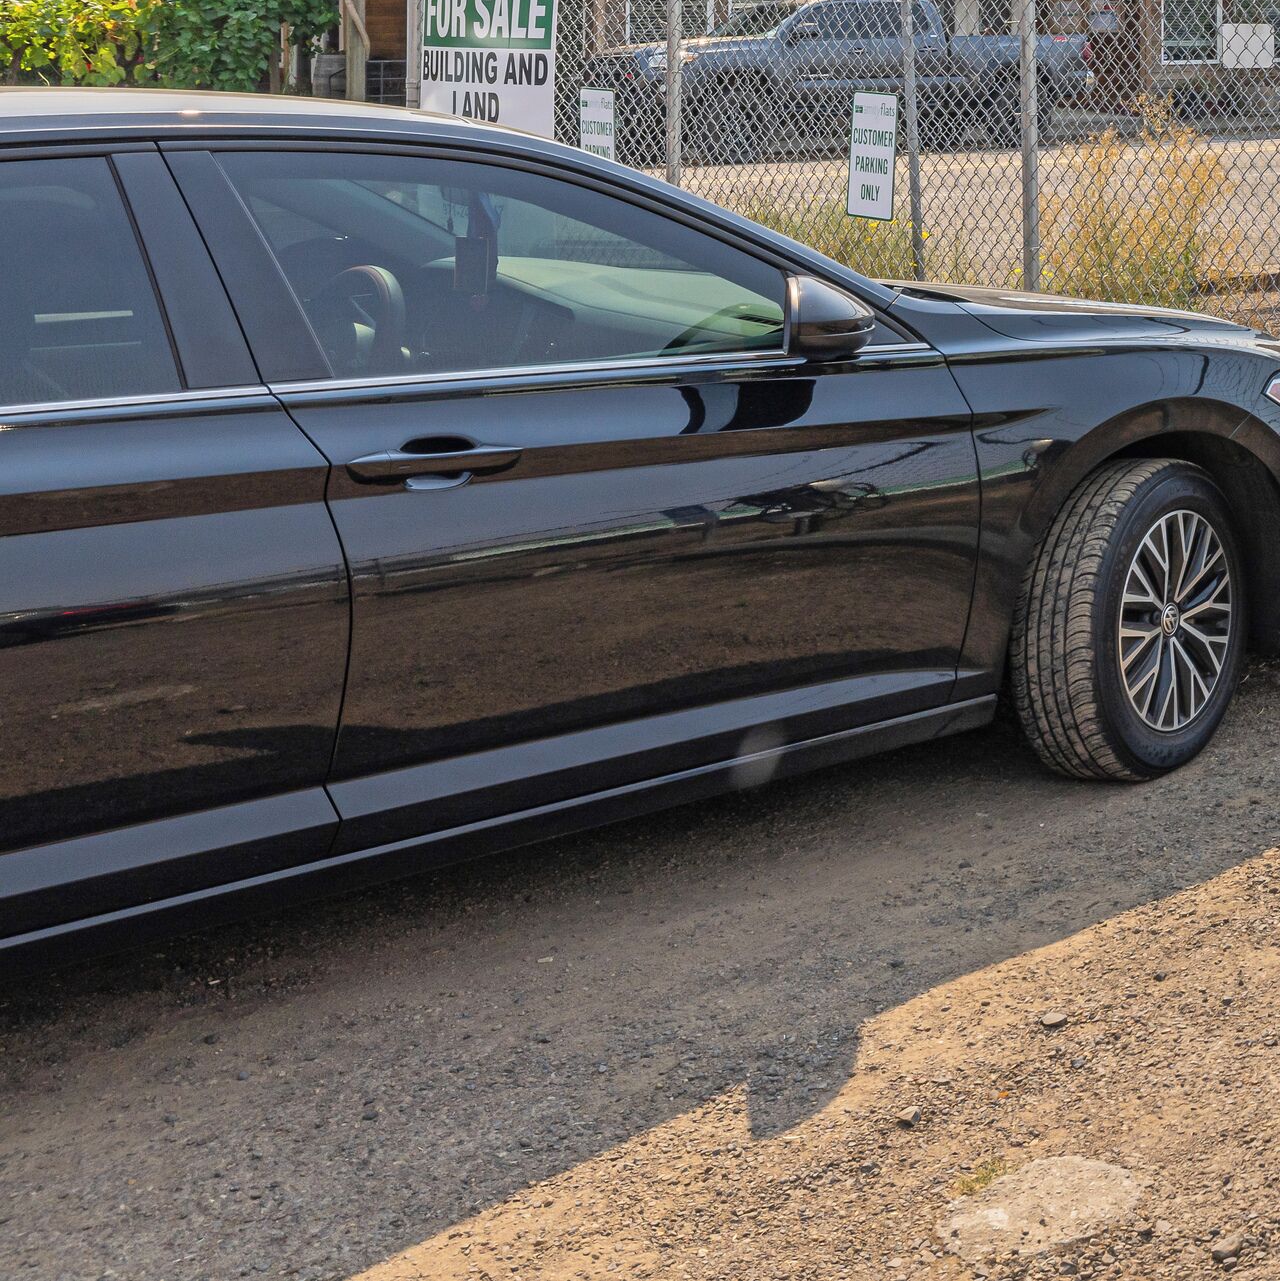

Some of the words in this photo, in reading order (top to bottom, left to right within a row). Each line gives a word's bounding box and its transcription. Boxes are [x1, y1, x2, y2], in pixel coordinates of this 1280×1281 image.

[423, 50, 498, 85] BUILDING
[503, 53, 549, 86] AND
[581, 120, 613, 136] CUSTOMER
[853, 127, 894, 148] CUSTOMER
[855, 155, 889, 175] PARKING
[860, 183, 880, 202] ONLY
